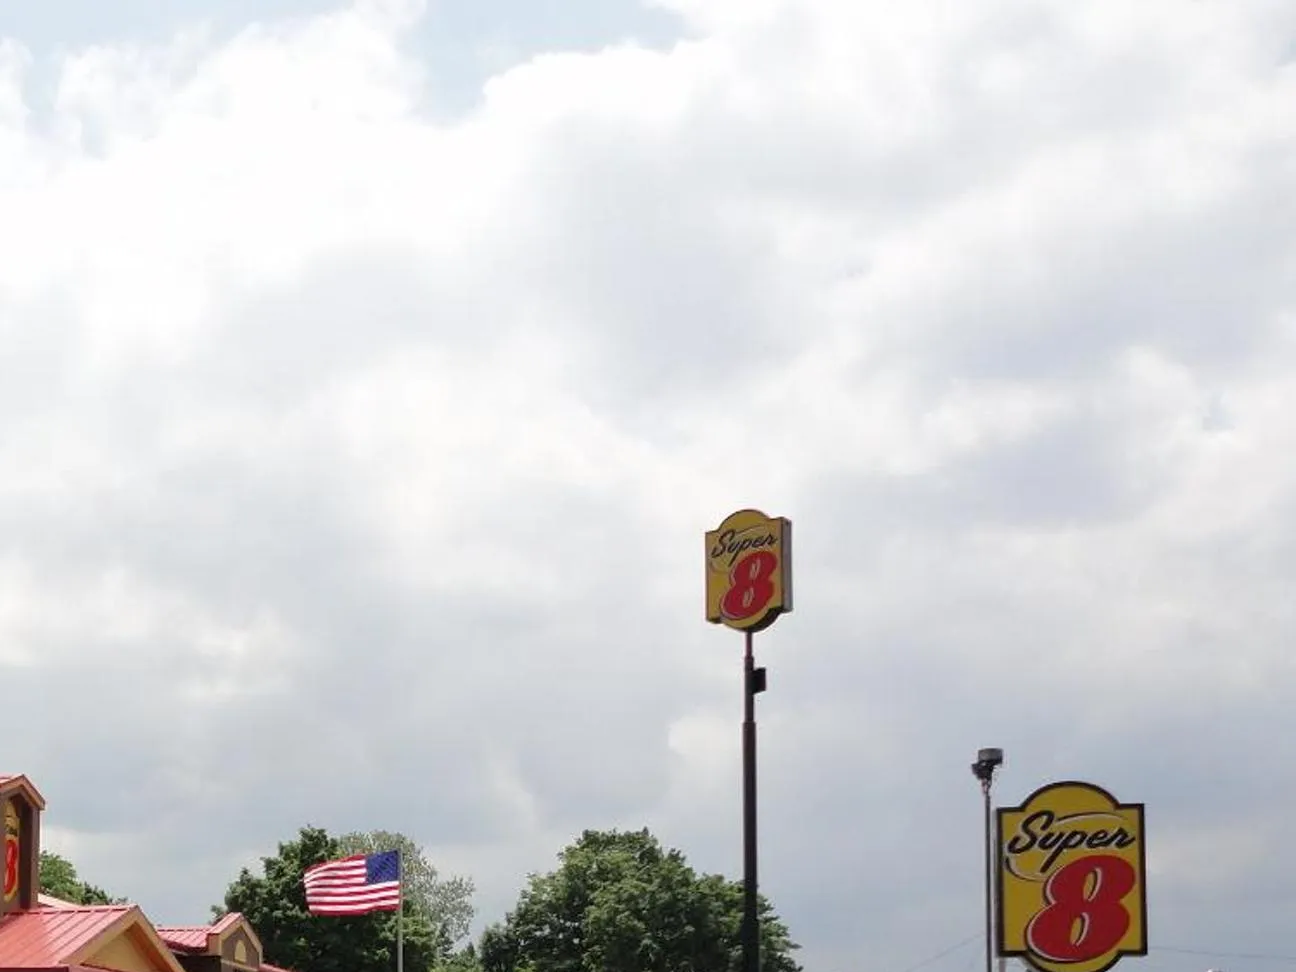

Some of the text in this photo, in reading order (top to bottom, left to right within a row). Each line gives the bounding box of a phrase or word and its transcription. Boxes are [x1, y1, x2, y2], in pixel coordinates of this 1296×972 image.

[711, 529, 777, 567] Super
[719, 550, 778, 621] 8
[1007, 810, 1136, 873] Super
[1024, 854, 1136, 963] 8
